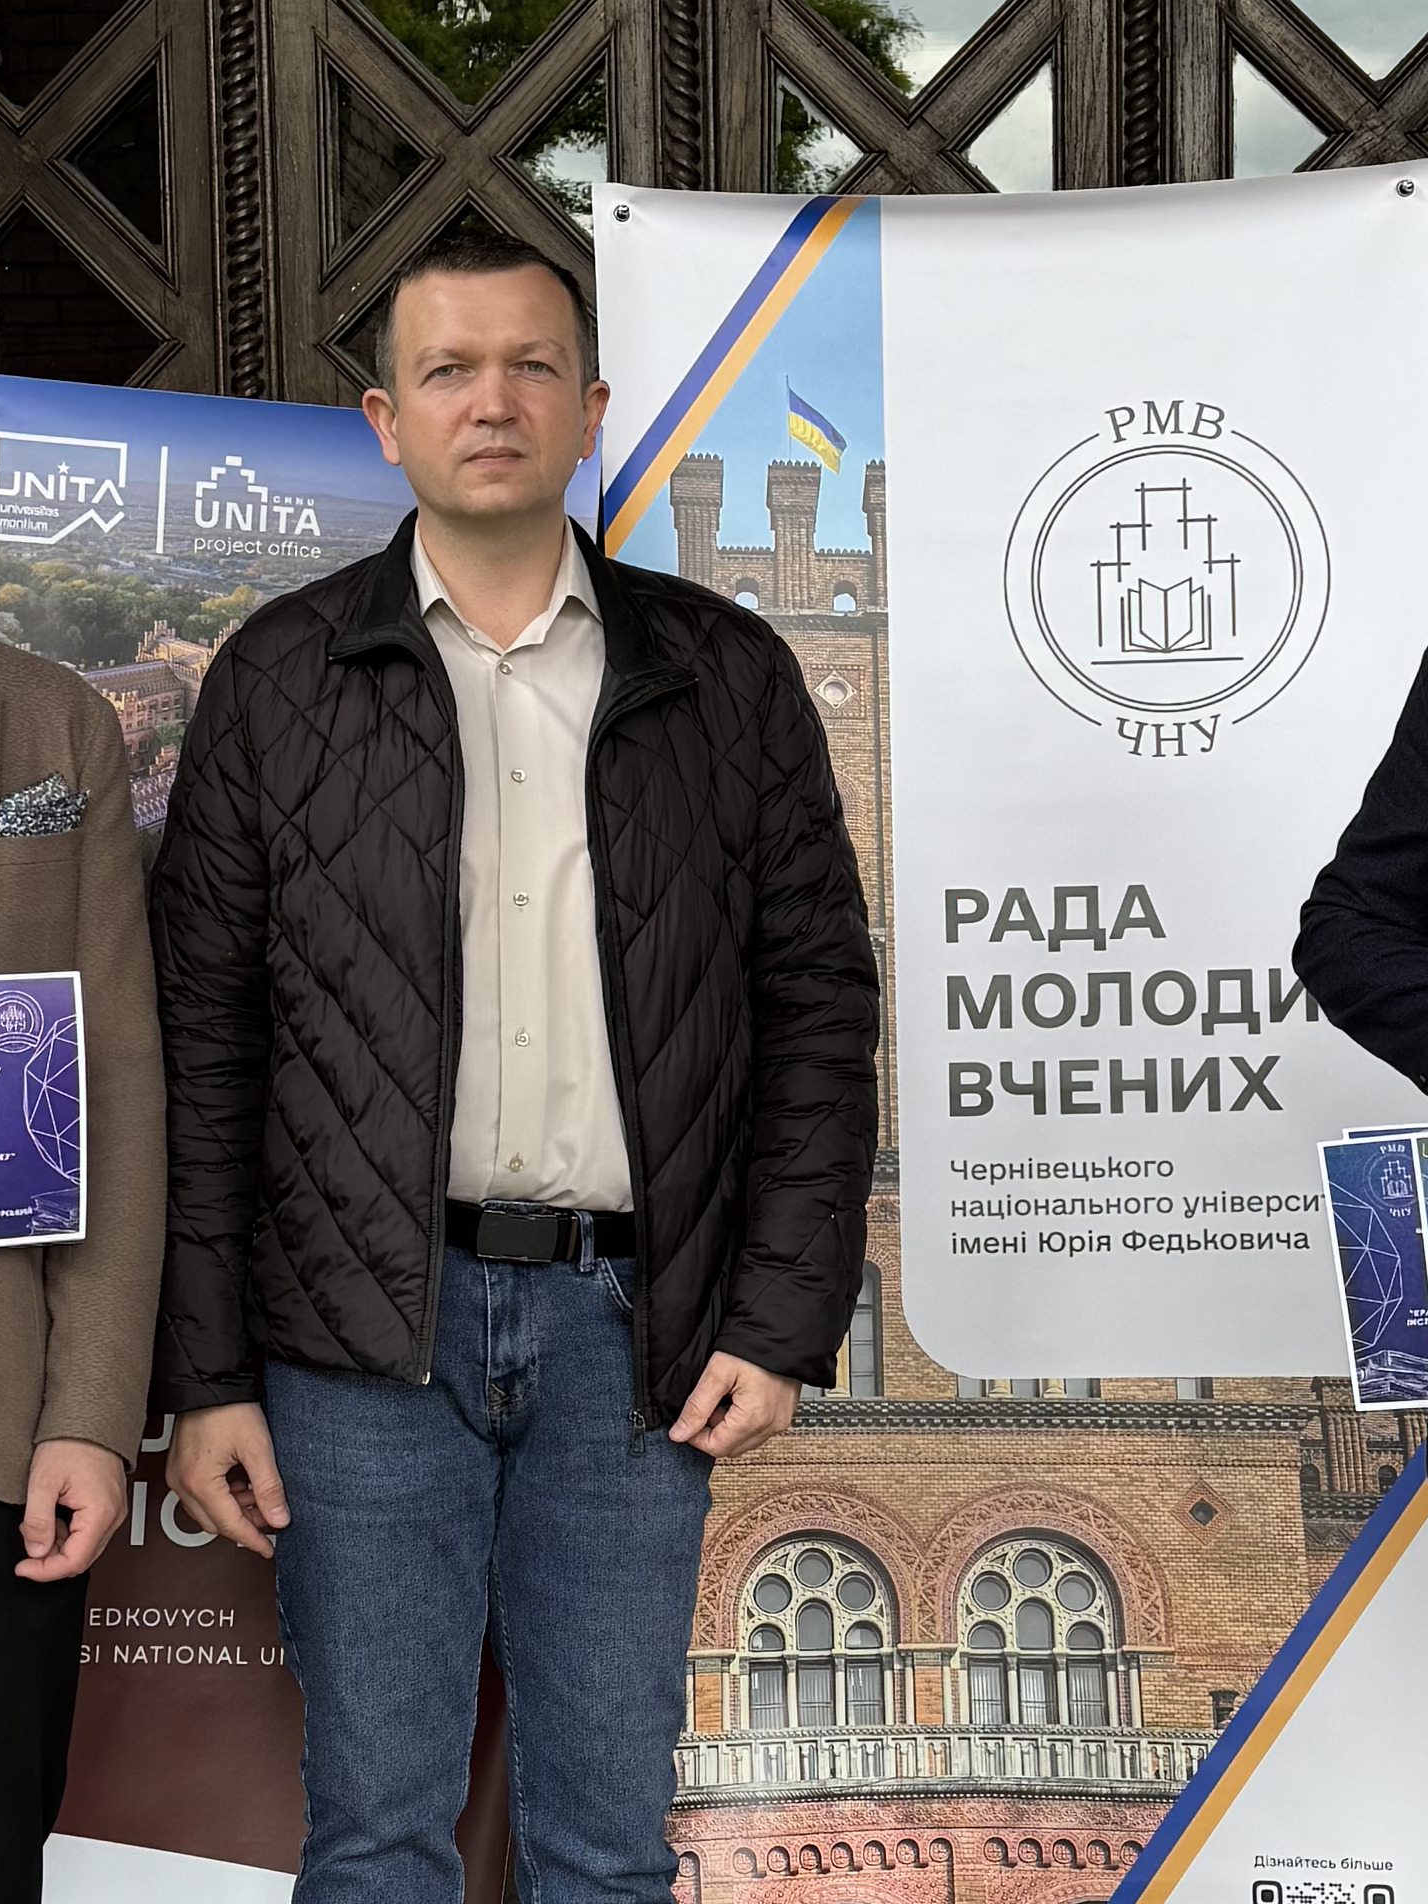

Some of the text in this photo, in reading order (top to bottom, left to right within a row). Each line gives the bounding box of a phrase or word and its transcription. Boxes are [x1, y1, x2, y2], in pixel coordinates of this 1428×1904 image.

[1104, 399, 1227, 443] РМВ
[0, 503, 60, 518] universitas
[194, 499, 321, 536] UNITA
[0, 517, 49, 533] montium
[194, 537, 322, 559] project office
[1116, 714, 1222, 758] ЧНУ
[944, 884, 1167, 952] РАДА
[948, 1055, 1284, 1118] ВЧЕНИХ
[950, 1156, 1174, 1184] Чернівецького
[950, 1191, 1325, 1219] національного універси
[951, 1228, 1310, 1258] імені Юрія Федьковича
[113, 1644, 248, 1665] NATIONAL
[1253, 1855, 1394, 1871] Дізнайтесь більше
